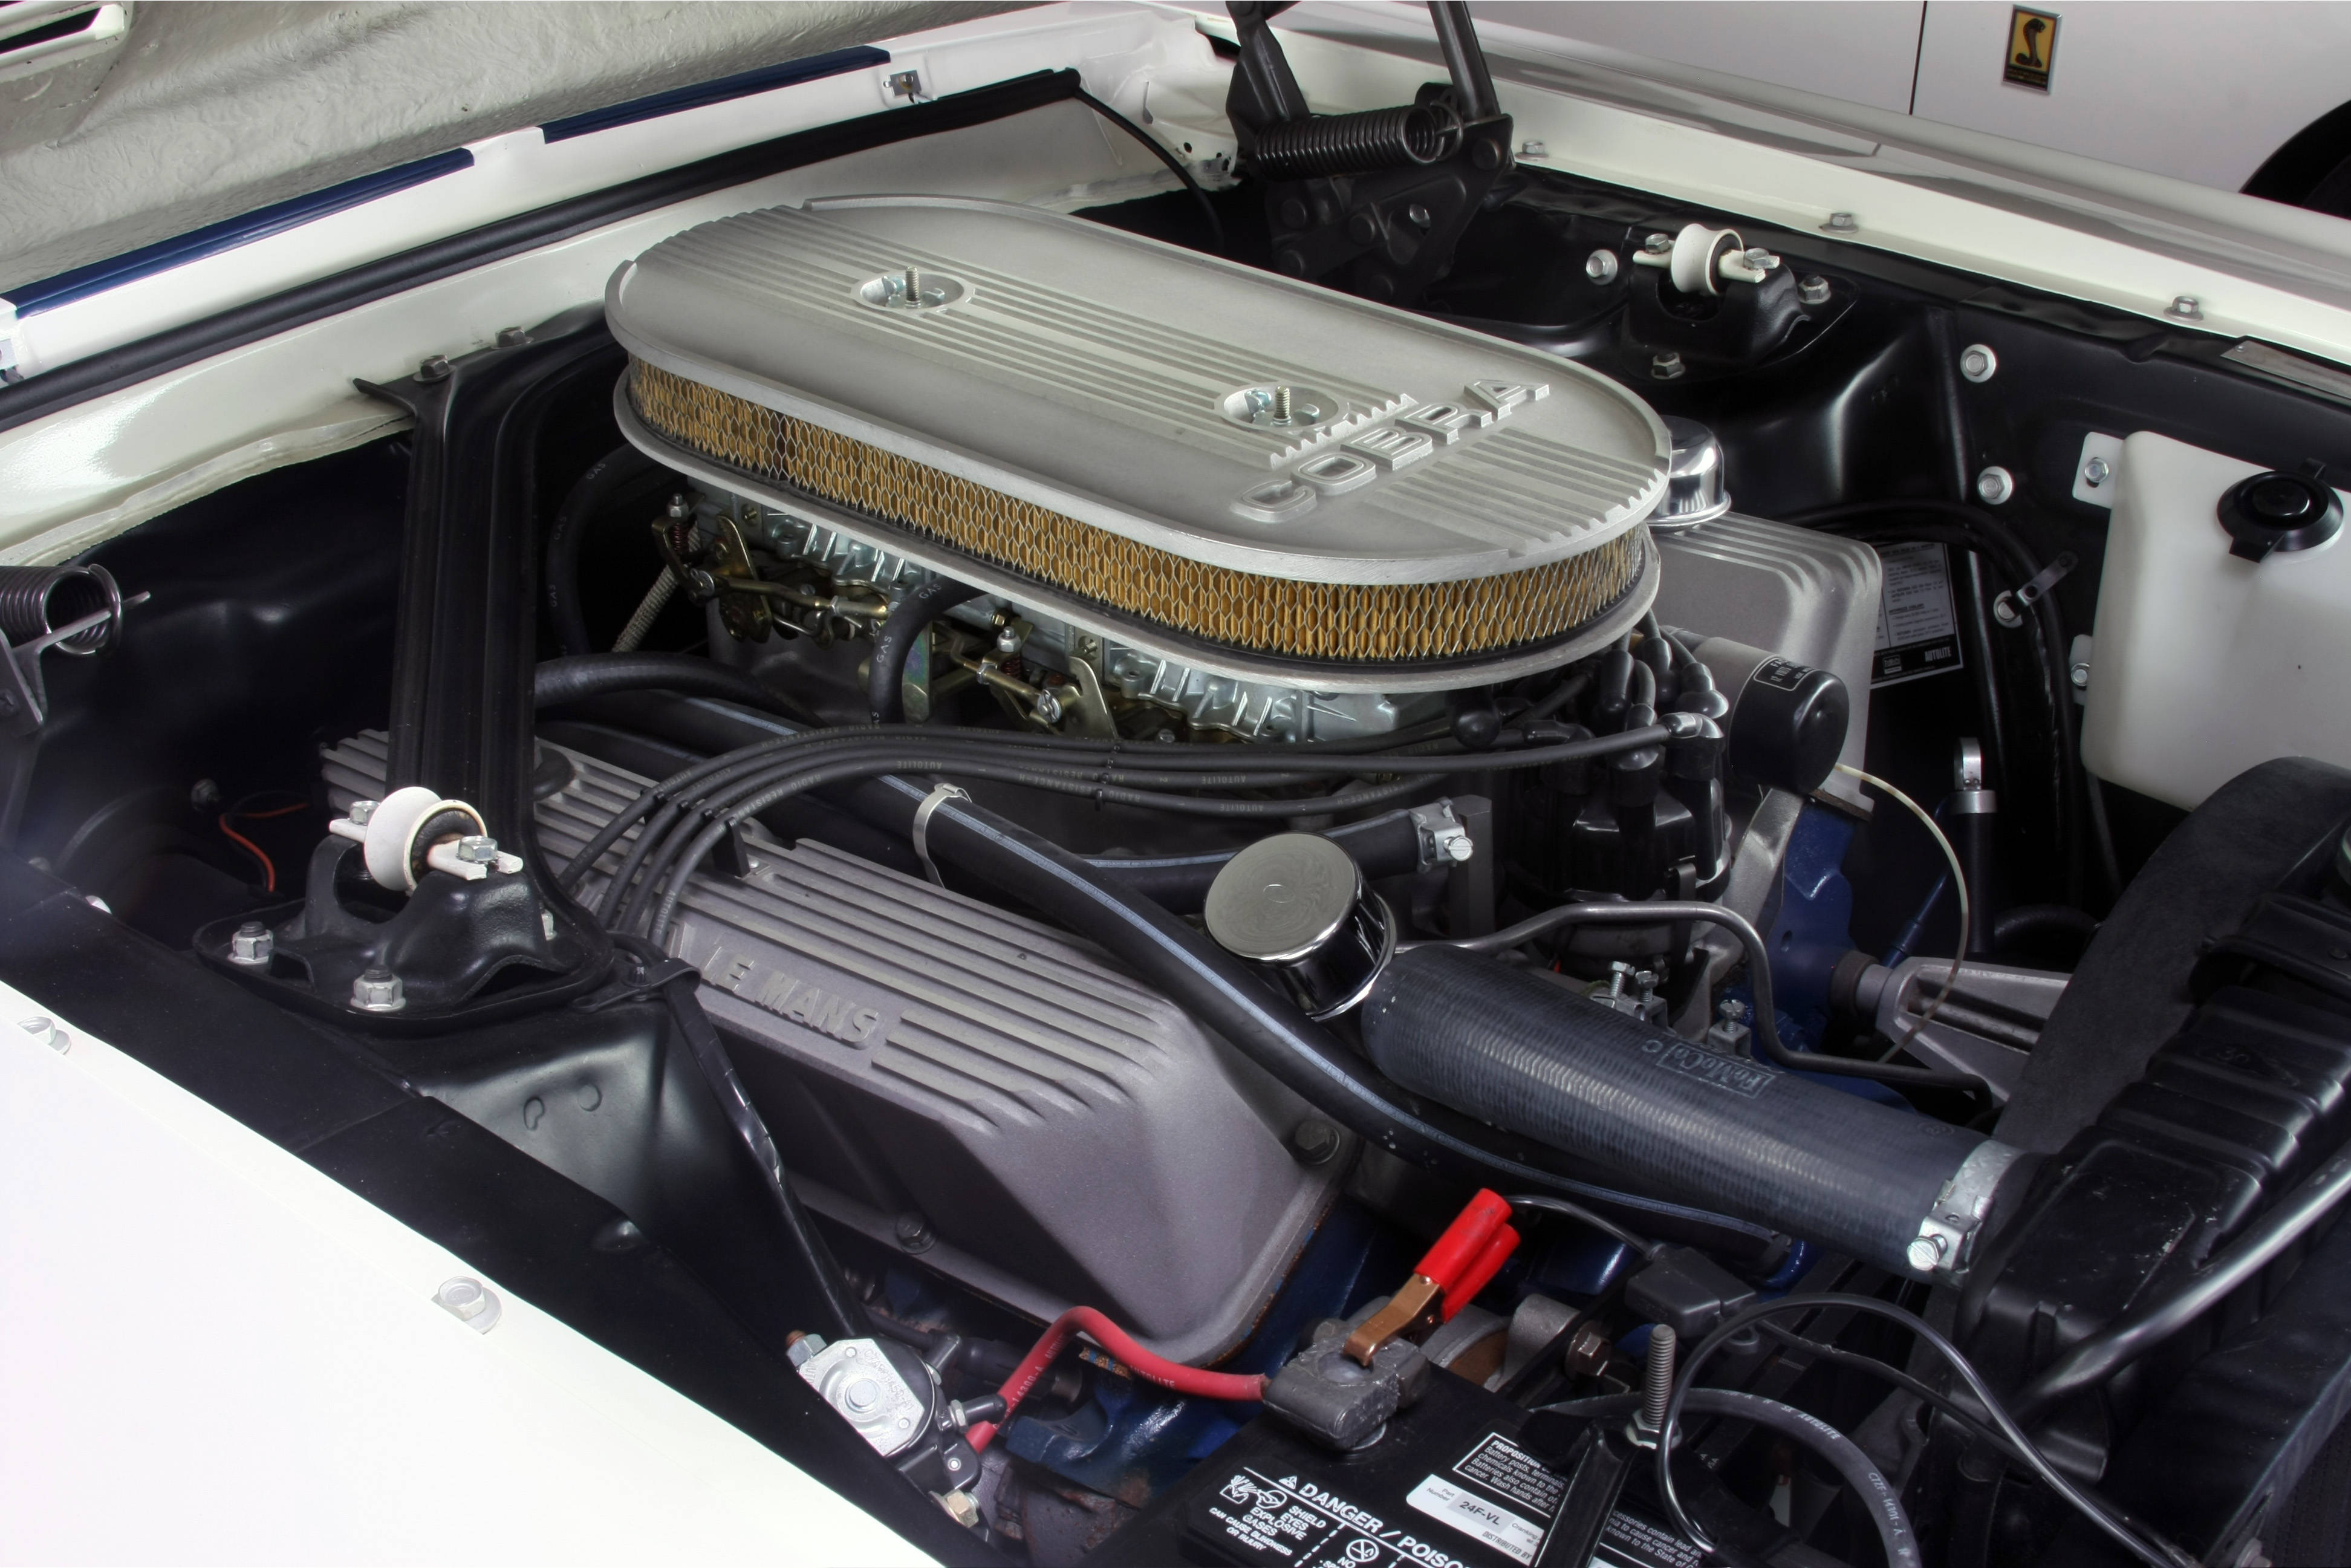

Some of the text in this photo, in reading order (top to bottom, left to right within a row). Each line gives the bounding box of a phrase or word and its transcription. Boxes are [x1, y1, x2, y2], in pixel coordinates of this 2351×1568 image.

[1230, 378, 1550, 523] COBRA
[919, 583, 943, 599] GAS
[876, 635, 893, 663] GAS
[1925, 646, 1951, 663] AUTOLITE
[897, 761, 943, 770] AUTOLITE
[790, 774, 822, 790] RADIO
[1016, 774, 1140, 802] RADIO ESISTANCE-H
[1201, 775, 1246, 785] AUTOLITE
[1219, 803, 1264, 812] AUTOLITE
[654, 890, 676, 934] AUTOLITE
[701, 945, 880, 1051] LE MANS
[1484, 1446, 1509, 1463] Battery
[1464, 1465, 1489, 1481] cancer.
[1490, 1475, 1510, 1490] Wash
[1510, 1485, 1533, 1500] hands
[1531, 1495, 1551, 1511] after
[1471, 1458, 1548, 1498] Batteries also contain
[1477, 1453, 1513, 1473] chemicals
[1513, 1469, 1537, 1485] known
[1536, 1480, 1546, 1489] to
[1546, 1485, 1559, 1495] the
[1426, 1488, 1451, 1502] Number
[1442, 1488, 1455, 1498] Part
[1242, 1514, 1278, 1537] GASES
[1250, 1506, 1308, 1541] EXPLOSIVE
[1281, 1512, 1309, 1531] EYES
[1288, 1505, 1327, 1529] SHIELD
[1299, 1483, 1384, 1534] DANGER
[1397, 1535, 1466, 1568] POISO
[1458, 1500, 1501, 1526] 24F-VL
[1209, 1506, 1293, 1557] CAN CAUSE BLINDNESS
[1226, 1526, 1267, 1550] OR INJURY
[1612, 1510, 1647, 1531] cessories
[1647, 1527, 1675, 1543] contain
[1674, 1538, 1691, 1552] lead
[1621, 1523, 1630, 1531] to
[1629, 1527, 1653, 1542] cause
[1652, 1540, 1679, 1555] cancer
[1677, 1550, 1694, 1563] and
[1481, 1531, 1523, 1555] DISTRIBUTED
[1521, 1551, 1532, 1560] BY
[1605, 1524, 1631, 1543] known
[1631, 1538, 1640, 1547] to
[1640, 1542, 1654, 1553] the
[1654, 1547, 1676, 1564] State
[1675, 1560, 1687, 1568] of
